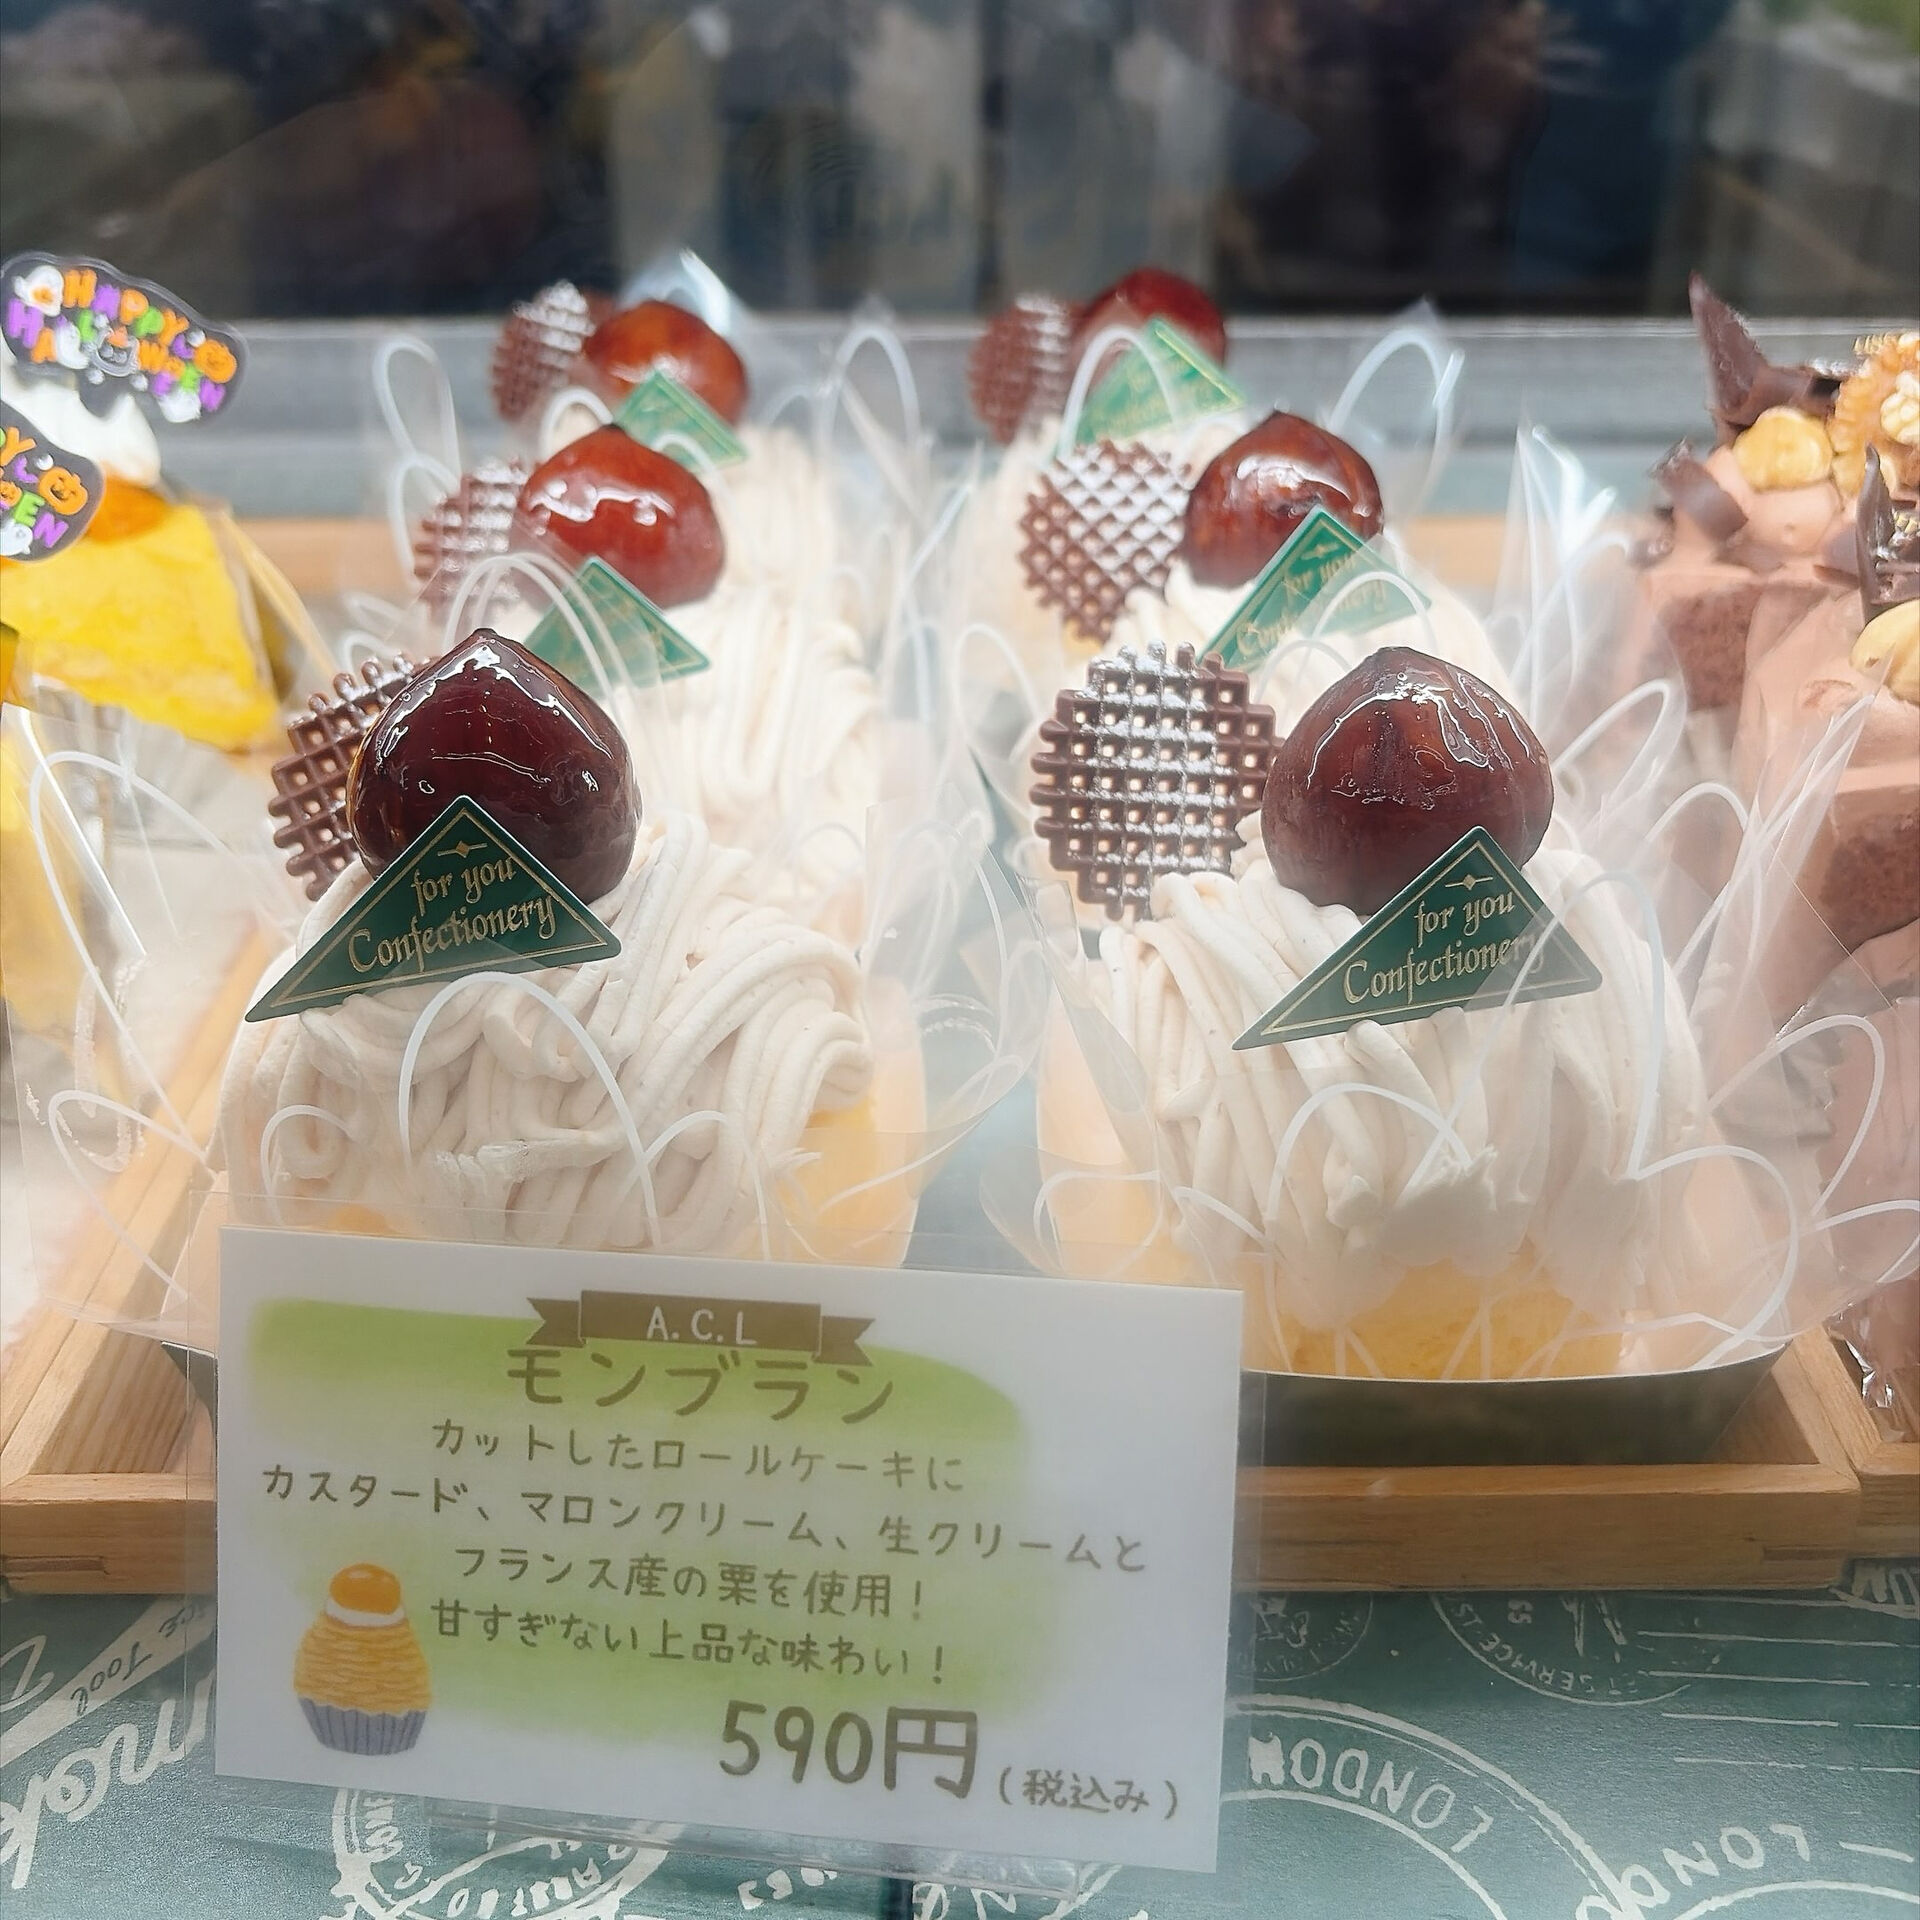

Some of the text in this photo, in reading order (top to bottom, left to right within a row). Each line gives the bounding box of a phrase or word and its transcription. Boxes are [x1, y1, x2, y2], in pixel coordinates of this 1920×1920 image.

[410, 856, 515, 917] for you
[1413, 890, 1516, 948] for you
[346, 894, 556, 974] Confectionery
[1342, 931, 1545, 1005] Confectionery
[645, 1305, 758, 1345] A.C.L
[506, 1348, 894, 1425] モンブラン
[431, 1418, 964, 1491] カットしたロールケーキに
[261, 1463, 1146, 1573] カスタード、マロンクリーム、生クリームと
[454, 1547, 922, 1621] フランス産の栗を使用！
[430, 1597, 944, 1685] 甘すぎない上品な味わい！
[719, 1699, 979, 1799] 590円
